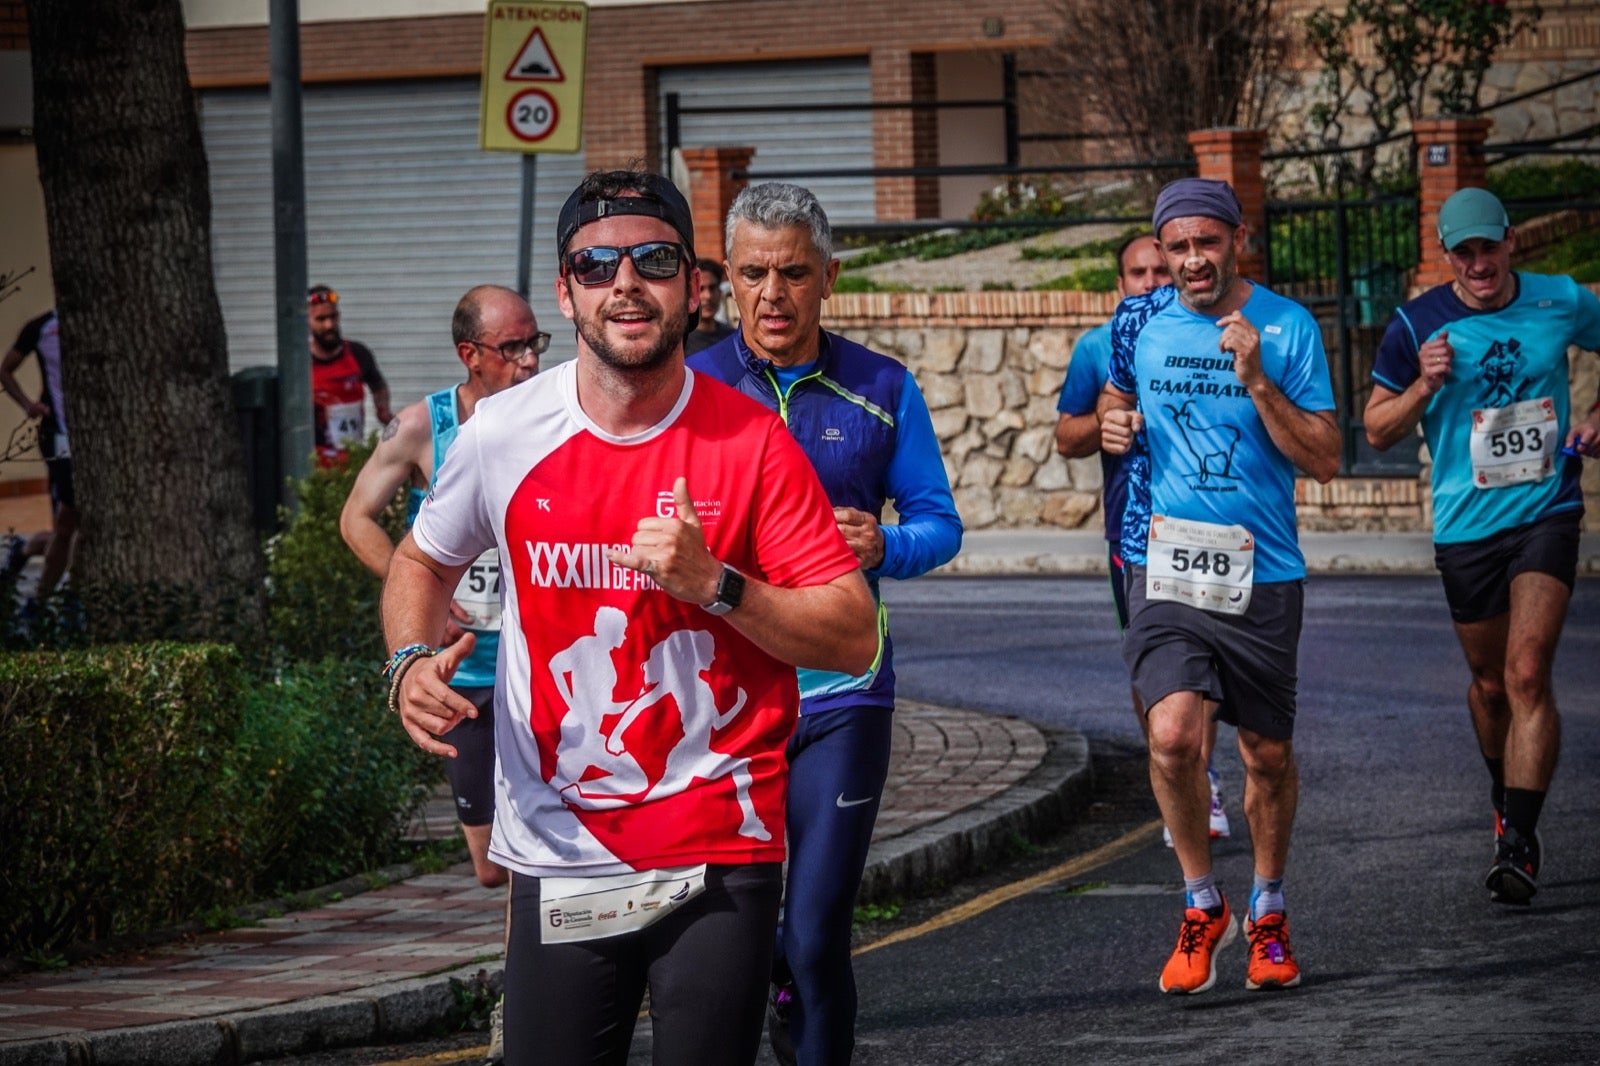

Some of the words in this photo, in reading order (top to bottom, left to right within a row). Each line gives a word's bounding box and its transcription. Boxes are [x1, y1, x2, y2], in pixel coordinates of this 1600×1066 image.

[518, 105, 549, 124] 20
[1491, 427, 1543, 457] 593
[525, 540, 609, 589] XXXIII
[1171, 548, 1231, 577] 548
[613, 566, 631, 590] DE
